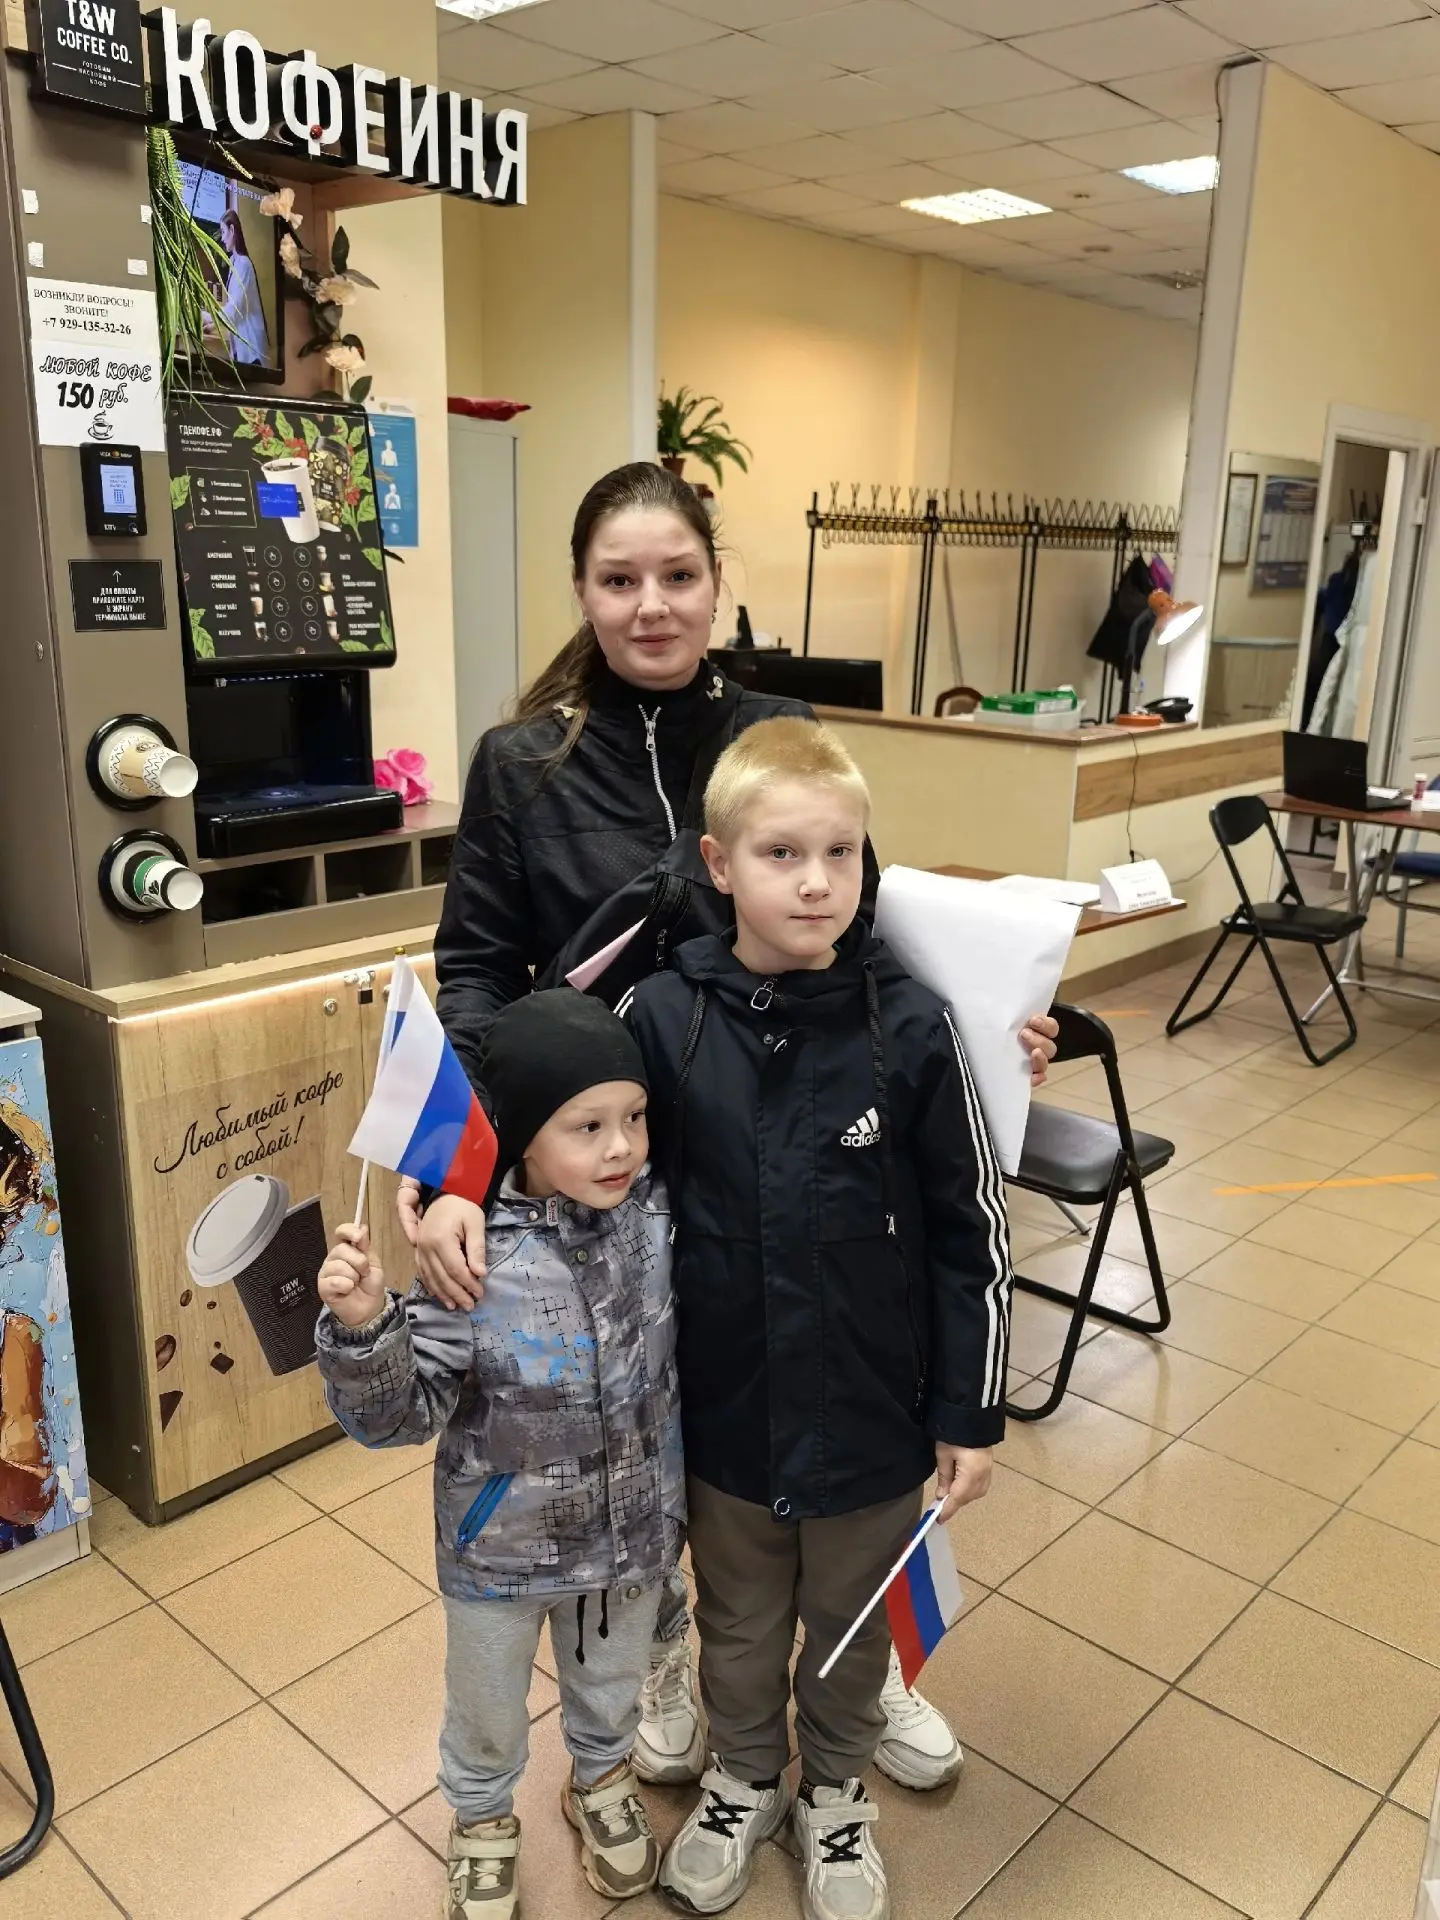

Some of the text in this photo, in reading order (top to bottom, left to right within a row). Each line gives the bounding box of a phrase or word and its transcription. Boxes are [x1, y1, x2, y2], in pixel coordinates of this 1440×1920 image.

[67, 0, 116, 36] T&W
[57, 27, 133, 65] COFFEE CO.
[34, 289, 85, 303] ВОЗНИКЛИ
[64, 304, 109, 317] ЗВОНИТЕ!
[42, 317, 132, 335] +7 929-135-32-26
[39, 355, 152, 382] ЛЮБОЙ КОФЕ
[57, 381, 129, 409] 150 руб.
[92, 596, 145, 604] ПРИЛОЖИТЕ КАРТУ
[95, 613, 129, 621] ТЕРМИНАЛА
[154, 1071, 344, 1174] Любимый кофе
[217, 1115, 305, 1180] с собой!
[840, 1131, 881, 1147] adidas
[280, 1277, 299, 1295] T&W
